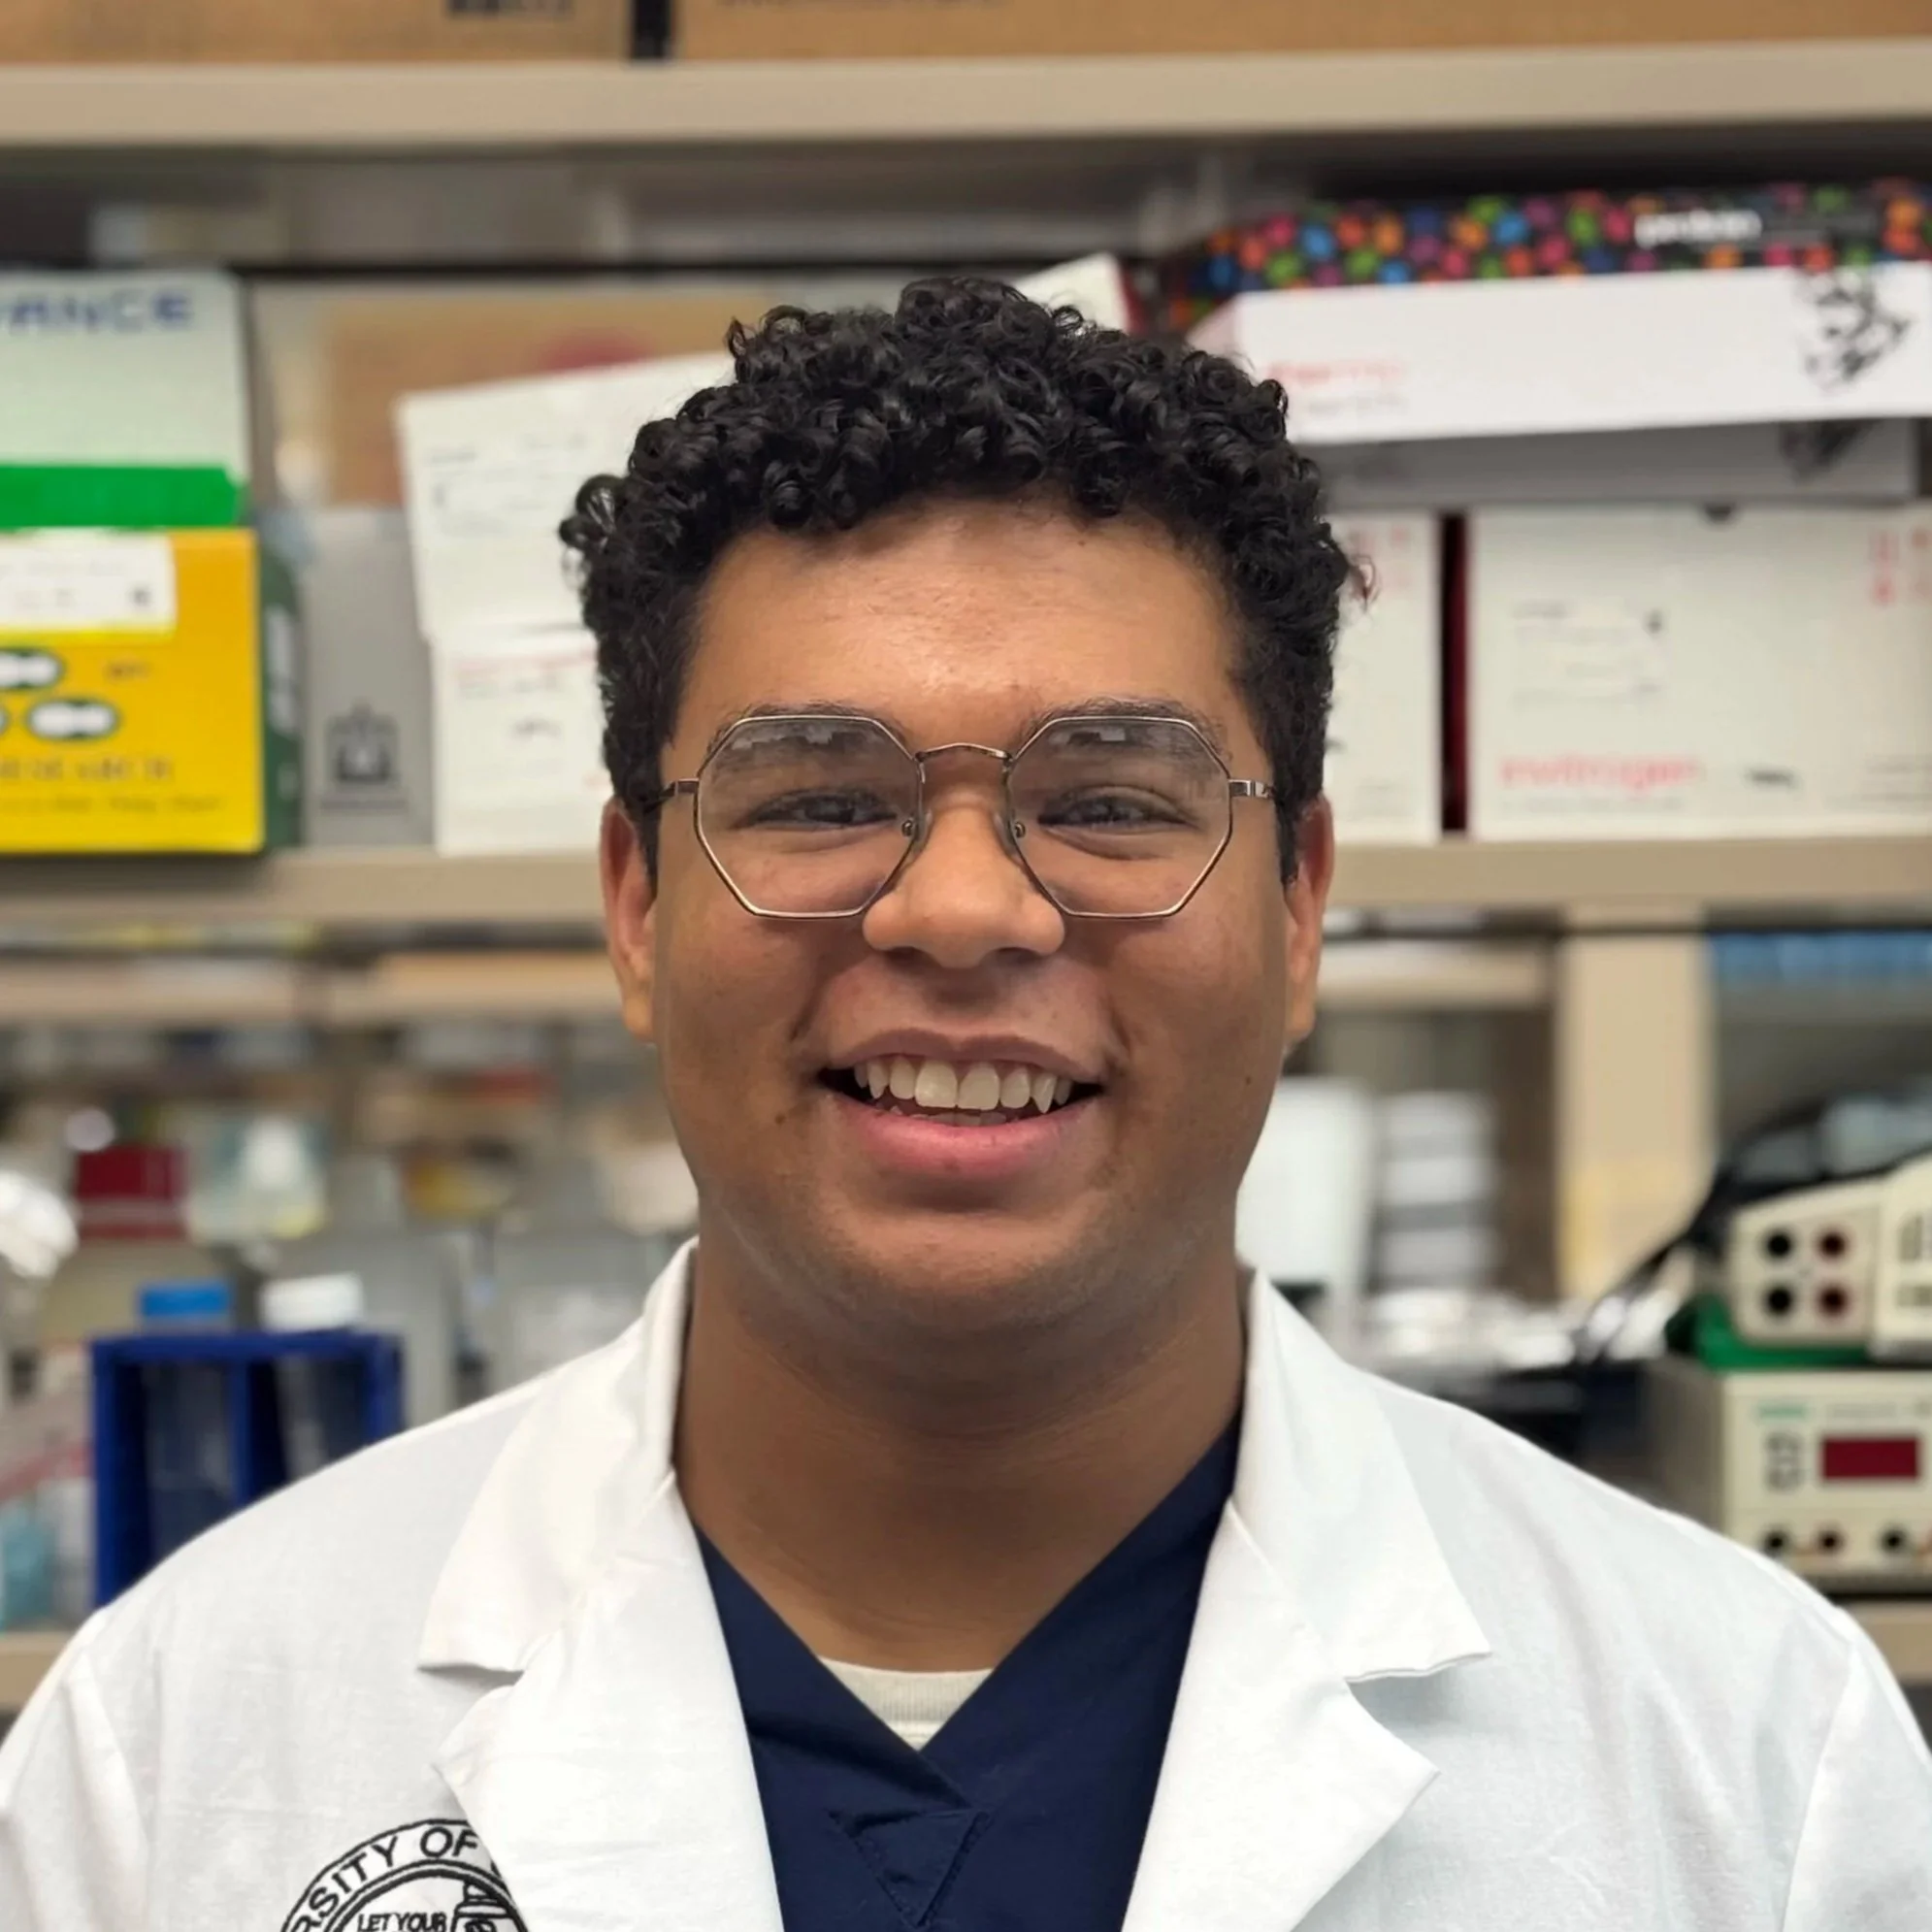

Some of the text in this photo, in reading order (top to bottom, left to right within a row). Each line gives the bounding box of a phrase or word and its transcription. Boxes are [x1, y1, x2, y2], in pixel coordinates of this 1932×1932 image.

[0, 289, 193, 335] ANCE
[420, 1826, 479, 1858] OF
[357, 1911, 447, 1932] LET YOUR
